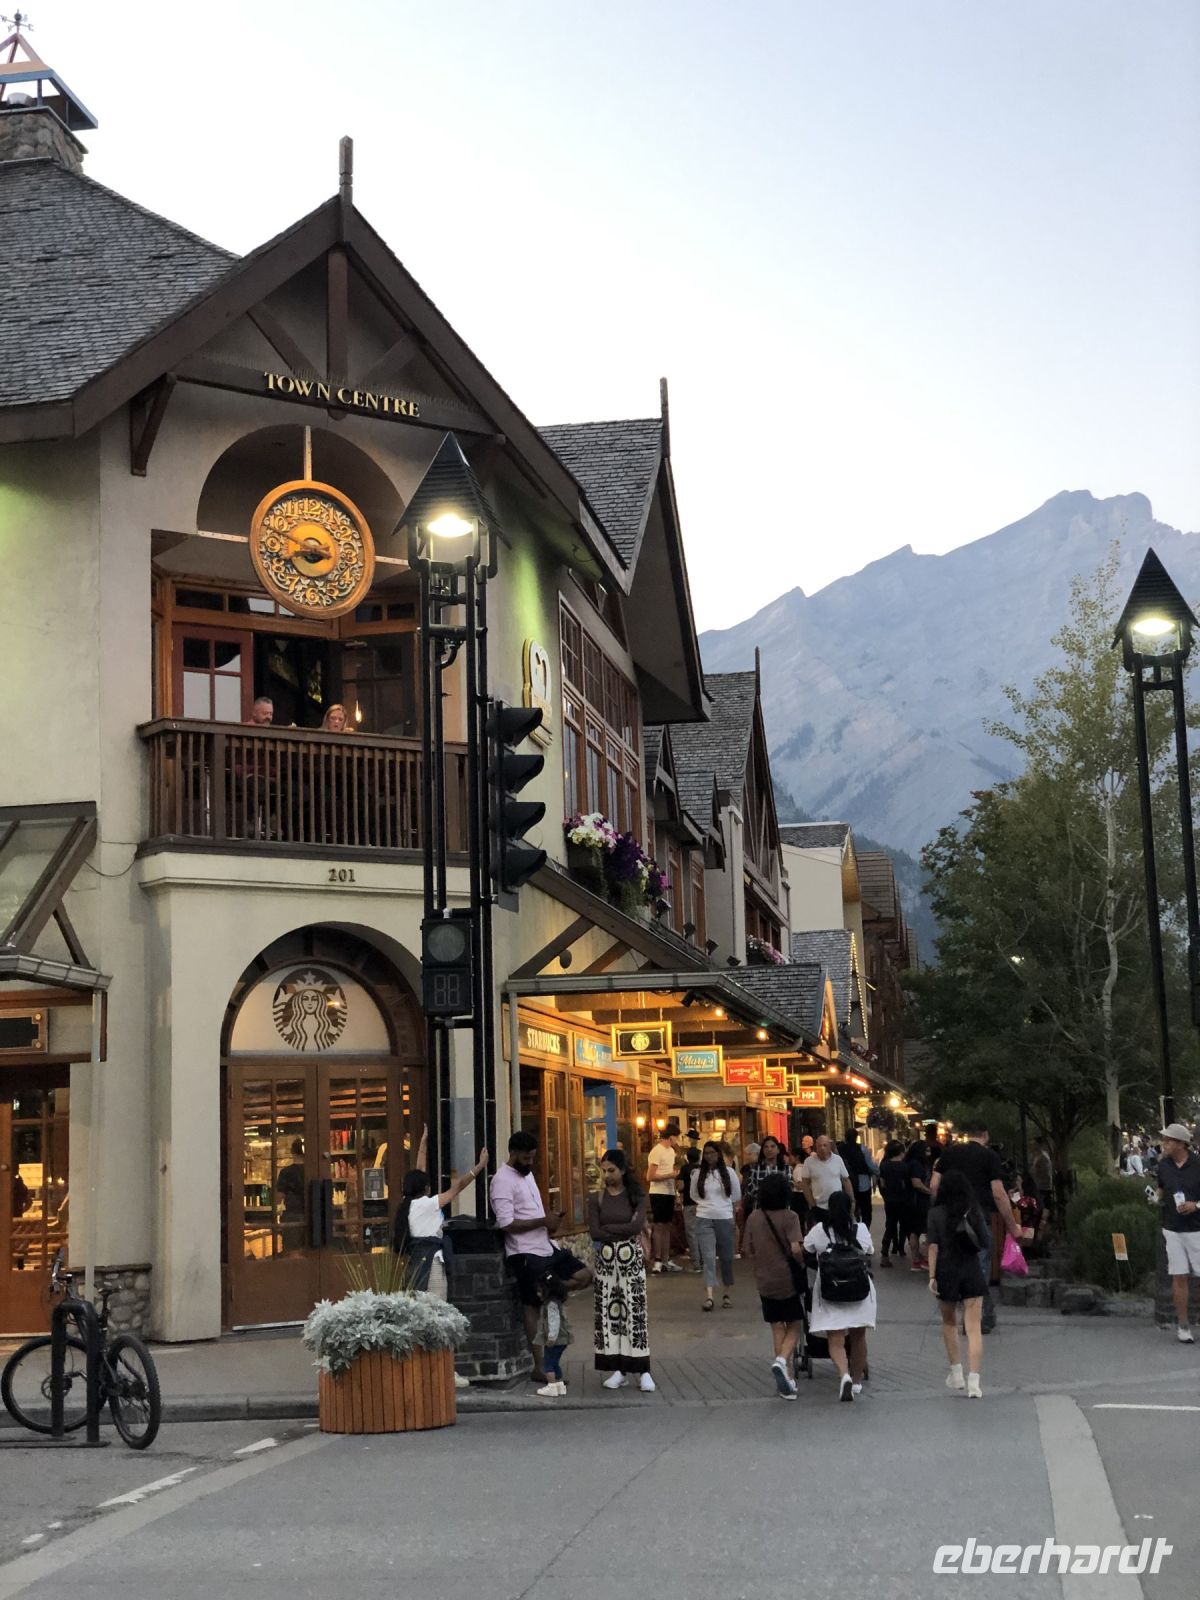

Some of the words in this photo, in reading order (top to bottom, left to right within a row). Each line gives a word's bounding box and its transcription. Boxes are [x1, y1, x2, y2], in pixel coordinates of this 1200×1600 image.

[264, 372, 331, 401] TOWN
[337, 387, 420, 418] CENTRE
[286, 500, 300, 518] 11
[303, 498, 321, 515] 12
[269, 515, 289, 532] 10
[339, 525, 353, 542] 2
[271, 557, 285, 573] 8
[341, 567, 353, 584] 4
[286, 575, 300, 594] 7
[327, 581, 339, 598] 5
[306, 586, 320, 604] 6
[328, 868, 356, 882] 201
[527, 1028, 561, 1055] STARBUCKS
[679, 1055, 714, 1069] Mary's
